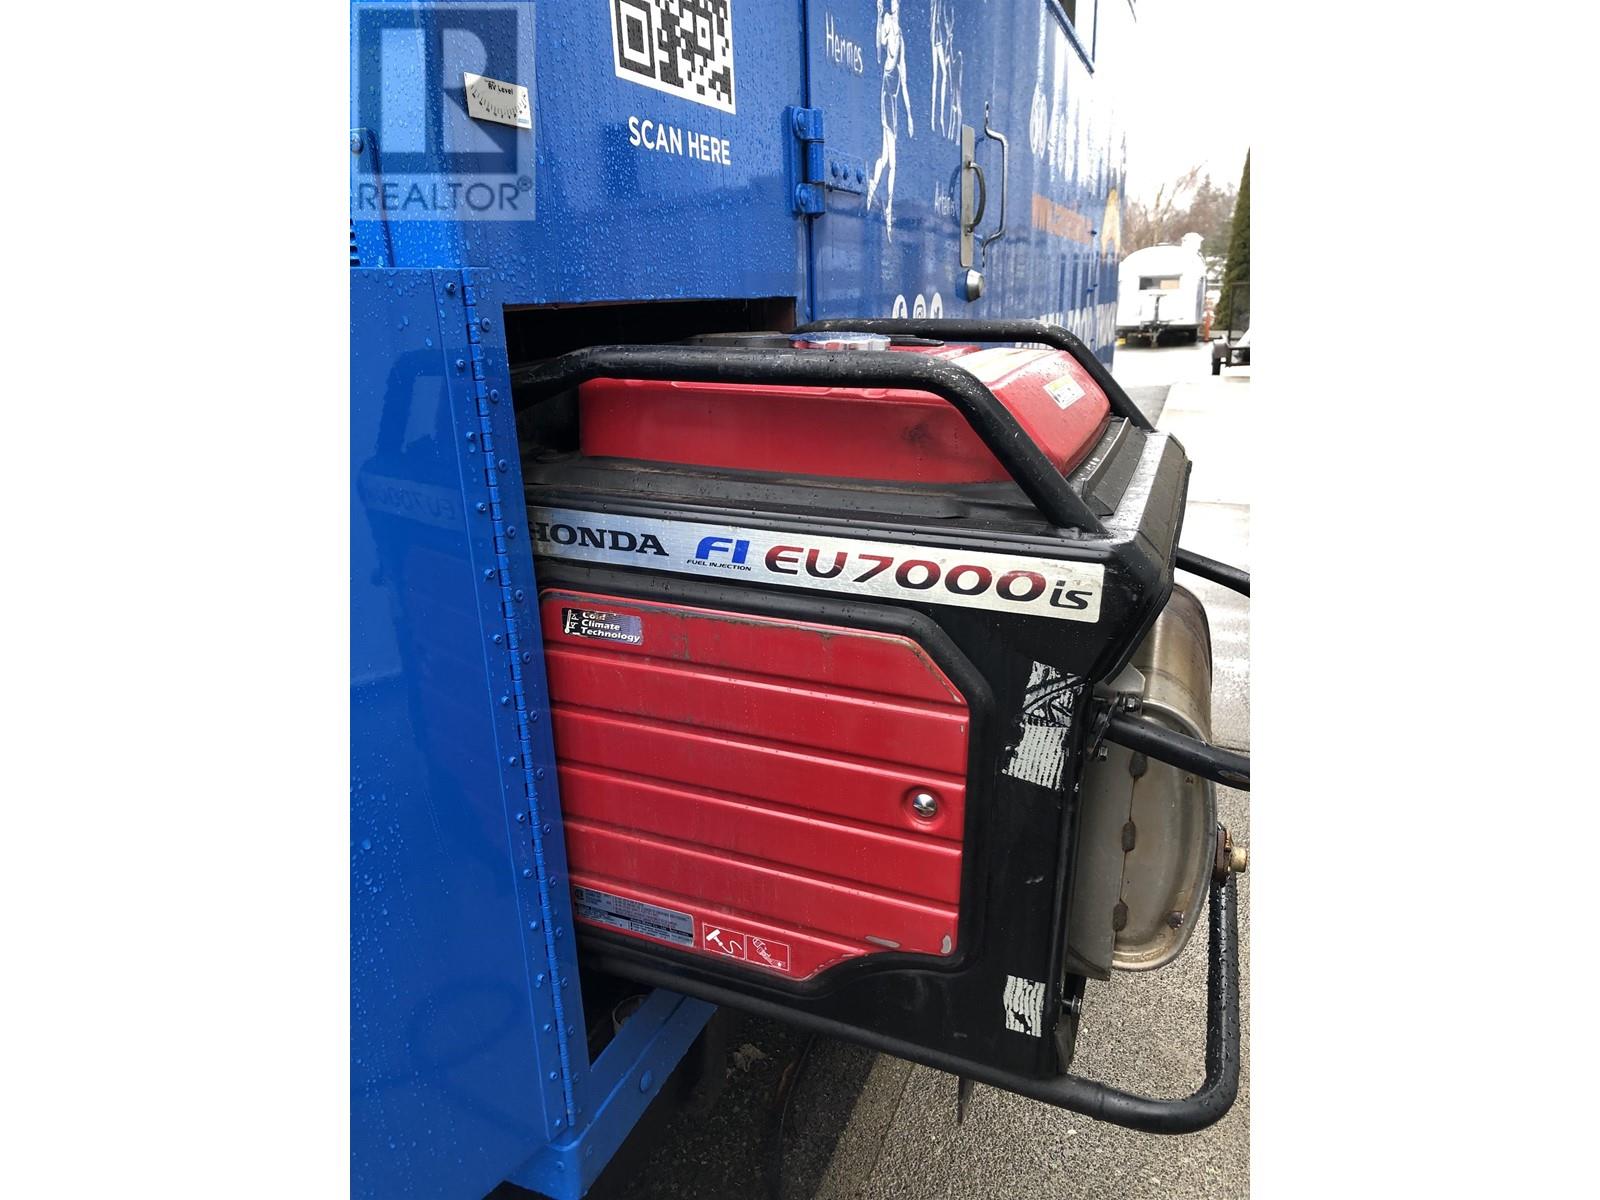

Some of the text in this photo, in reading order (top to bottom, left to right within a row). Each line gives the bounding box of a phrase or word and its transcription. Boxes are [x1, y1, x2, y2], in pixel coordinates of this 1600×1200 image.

[826, 12, 863, 73] Hermes
[498, 85, 514, 95] Level
[628, 116, 731, 166] SCAN HERE
[529, 522, 669, 556] HONDA
[695, 536, 750, 564] FI
[709, 562, 752, 571] INJECTION
[582, 611, 606, 621] Cold
[581, 619, 620, 631] Climate
[580, 626, 640, 643] Technology
